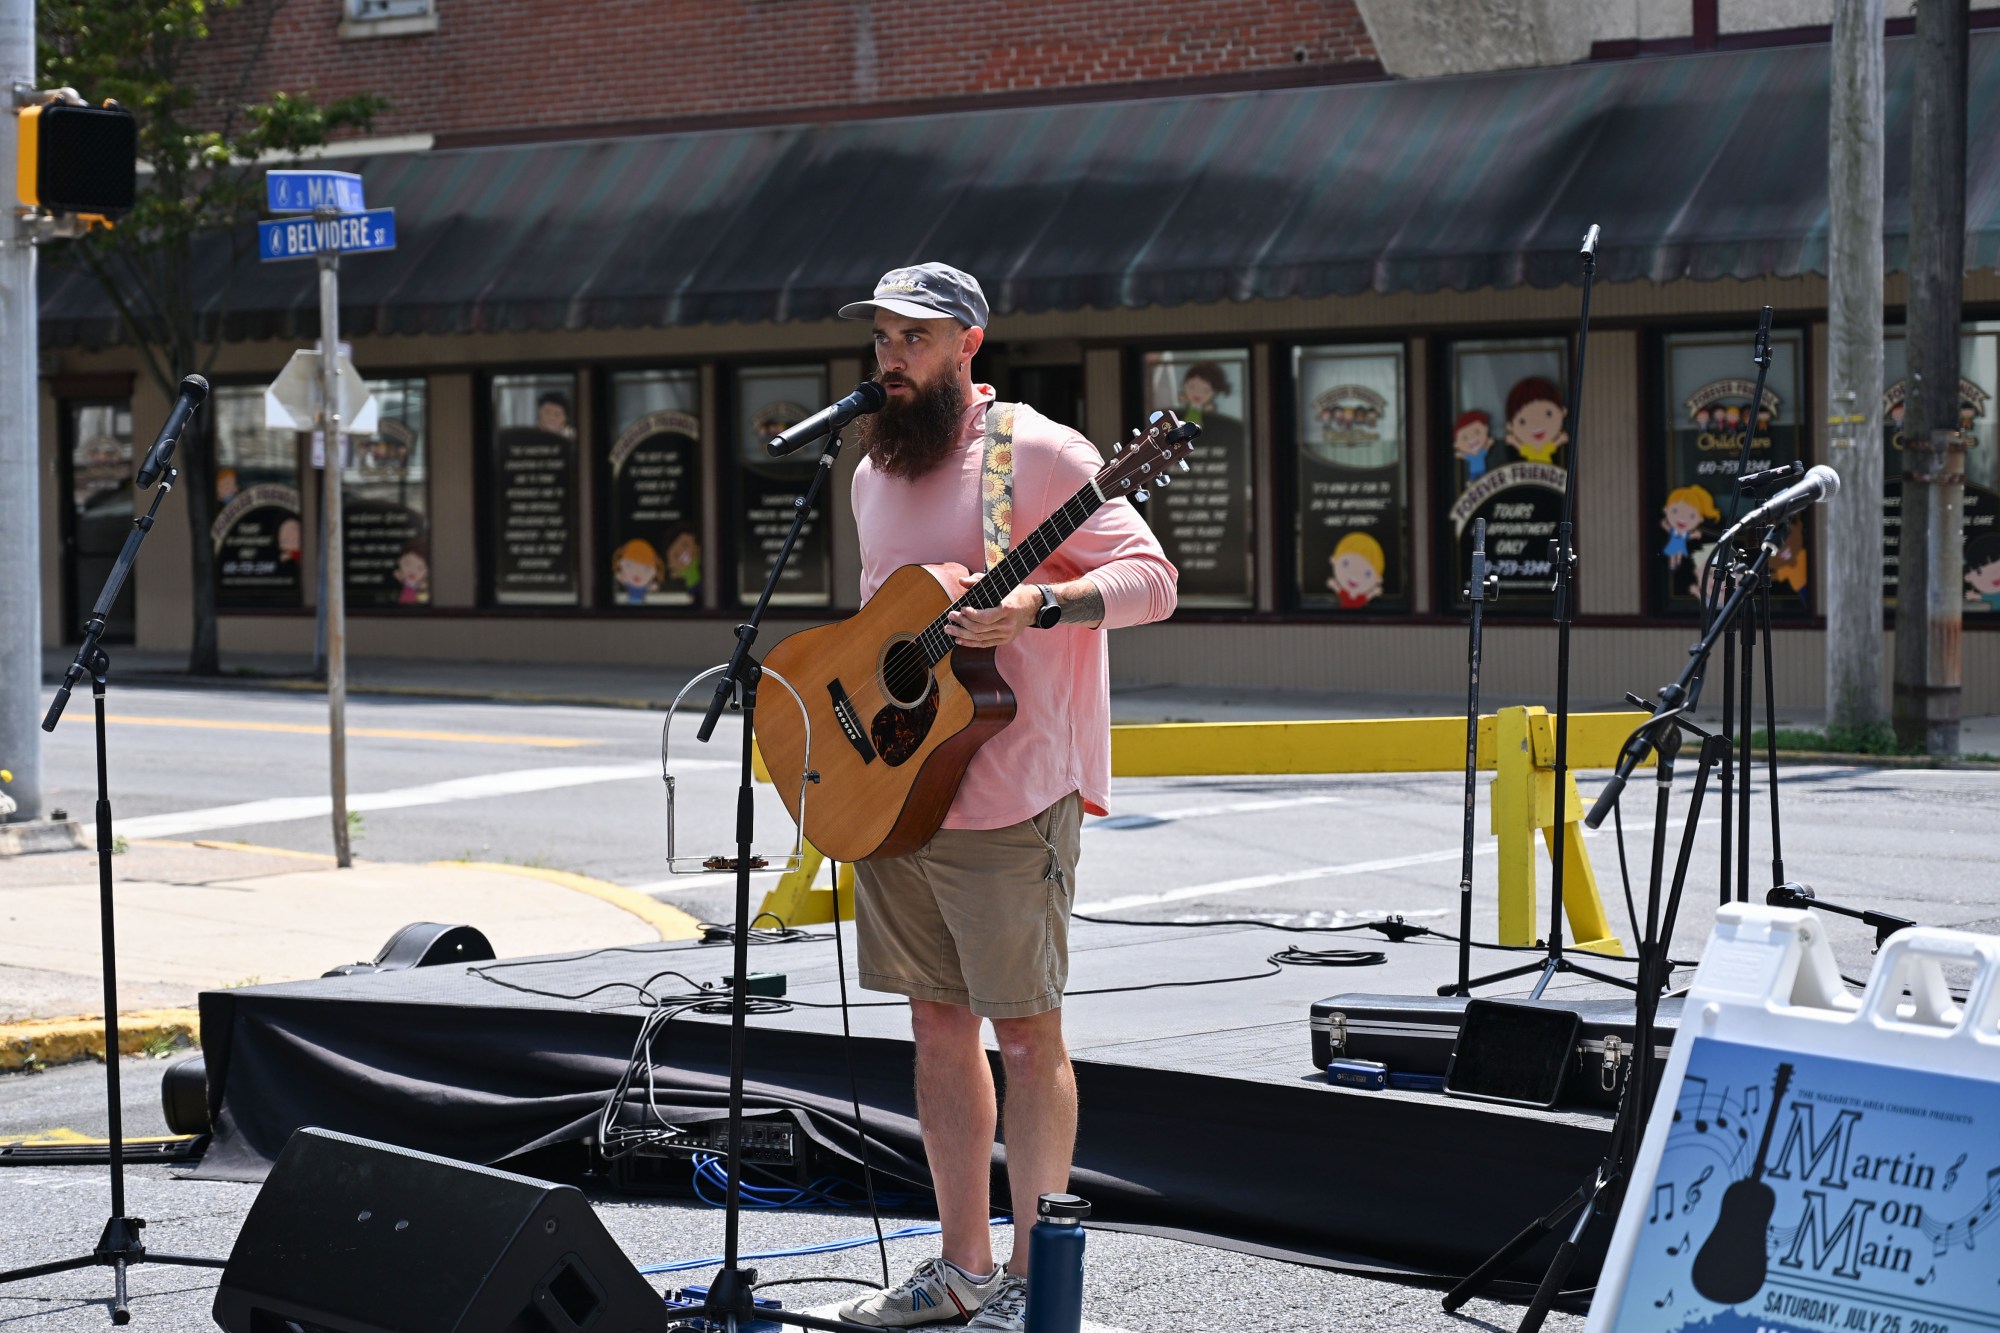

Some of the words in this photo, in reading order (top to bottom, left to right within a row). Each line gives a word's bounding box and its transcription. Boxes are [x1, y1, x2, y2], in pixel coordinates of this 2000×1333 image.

[296, 190, 304, 207] S
[287, 217, 370, 254] BELVIDERE
[1456, 471, 1507, 518] FOREVER
[1511, 466, 1567, 487] FRIENDS
[1493, 503, 1535, 519] TOURS
[1487, 521, 1557, 536] APPOINTMENT
[1495, 540, 1529, 555] ONLY
[1768, 1101, 1935, 1190] Martin
[1881, 1199, 1923, 1229] on
[1779, 1190, 1913, 1280] Main
[1764, 1291, 1840, 1328] SATURDAY,
[1842, 1308, 1881, 1333] JULY
